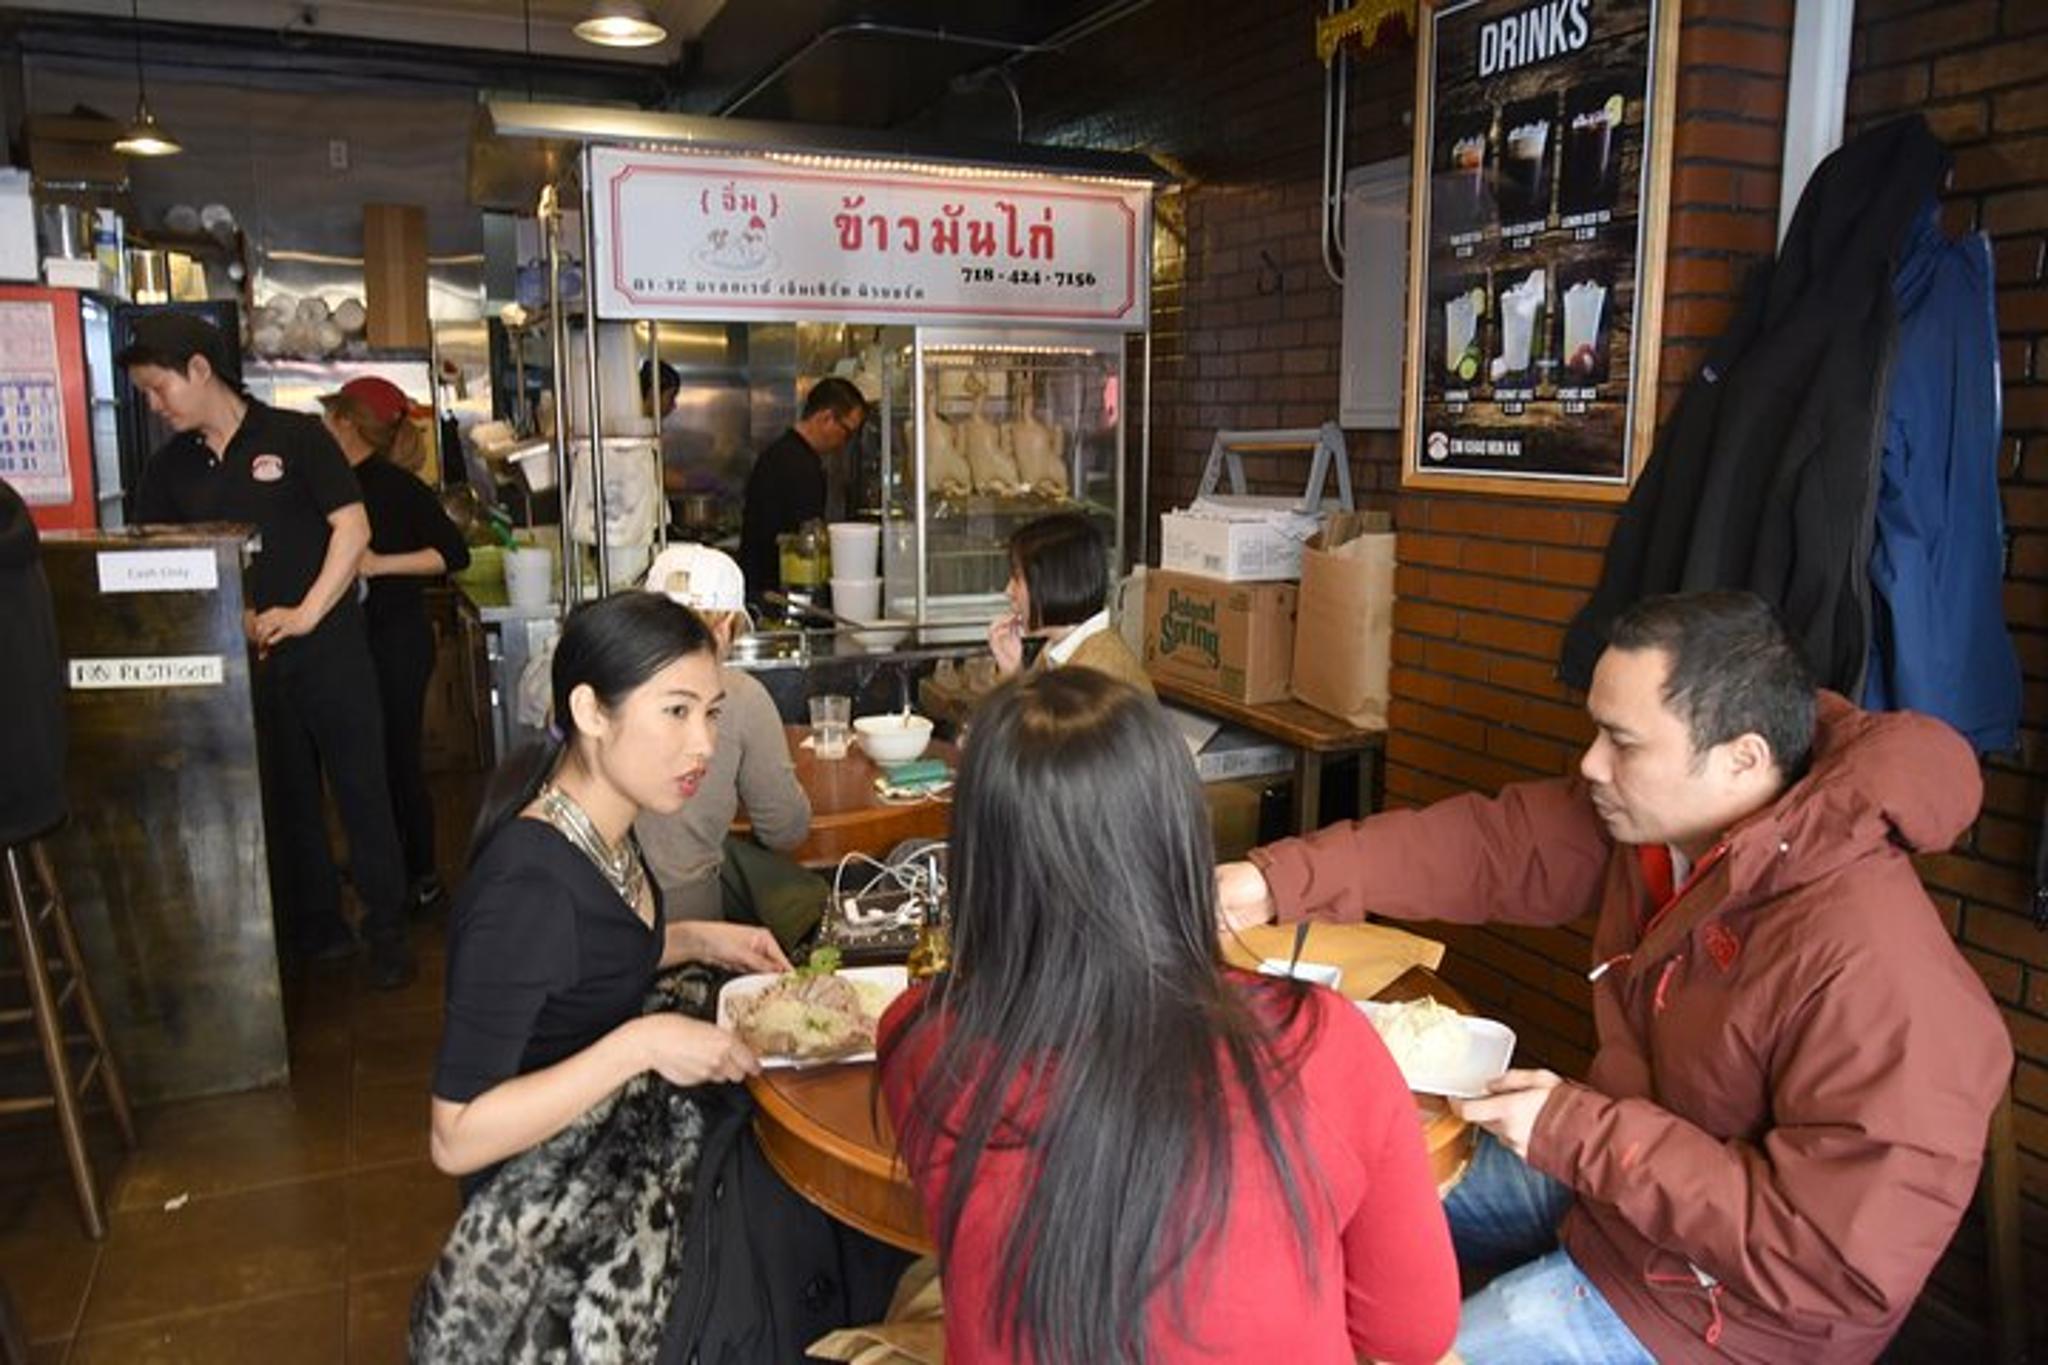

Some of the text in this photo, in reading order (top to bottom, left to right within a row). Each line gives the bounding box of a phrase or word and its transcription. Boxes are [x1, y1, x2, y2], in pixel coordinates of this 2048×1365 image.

[1480, 0, 1589, 78] DRINKS
[834, 195, 1055, 260] ข้าวมันไก่
[1168, 588, 1215, 625] Poland
[1160, 613, 1220, 671] Spring
